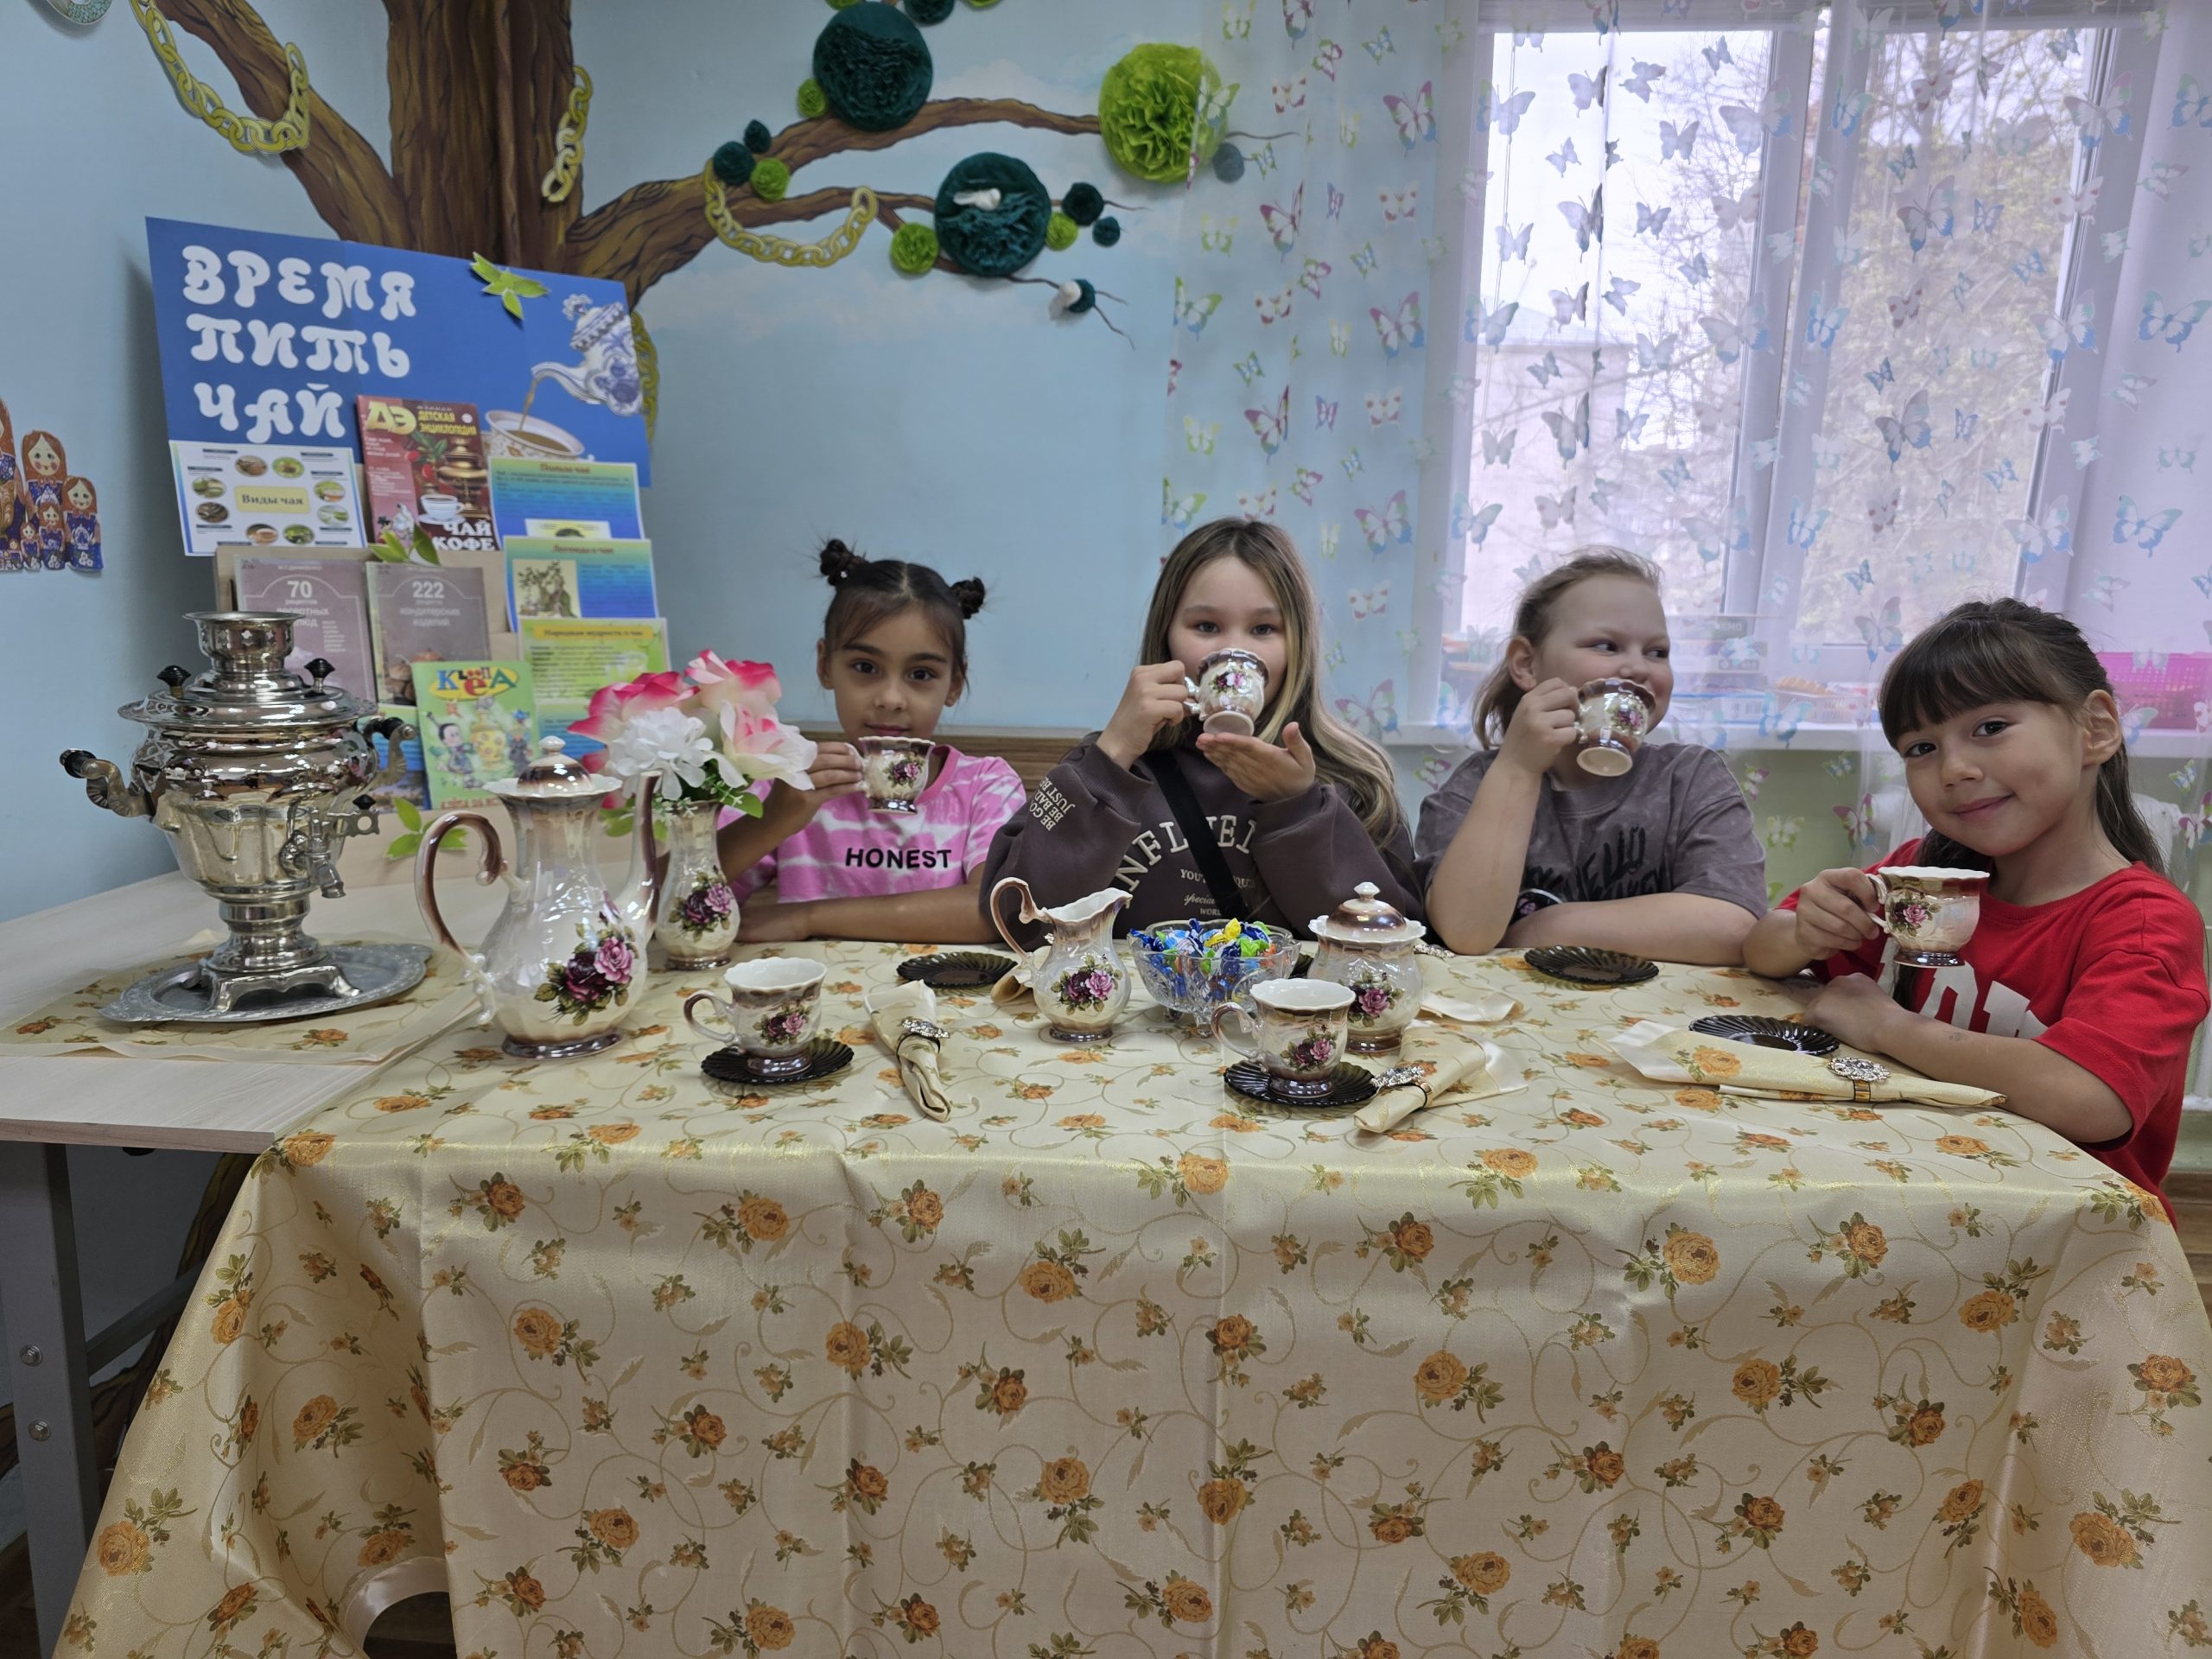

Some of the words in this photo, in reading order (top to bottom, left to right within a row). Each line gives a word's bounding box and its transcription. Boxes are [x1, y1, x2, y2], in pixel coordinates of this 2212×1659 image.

[182, 245, 416, 321] ВРЕМЯ
[186, 313, 410, 378] ПИТЬ
[194, 382, 346, 443] ЧАЙ
[242, 493, 278, 505] Виды
[279, 496, 304, 505] чая
[443, 519, 493, 537] ЧАЙ
[433, 536, 496, 551] КОФЕ
[287, 580, 313, 599] 70
[412, 580, 445, 599] 222
[1046, 786, 1076, 815] JUST
[1039, 814, 1057, 831] BE
[1048, 806, 1065, 823] BE
[845, 847, 952, 870] HONEST
